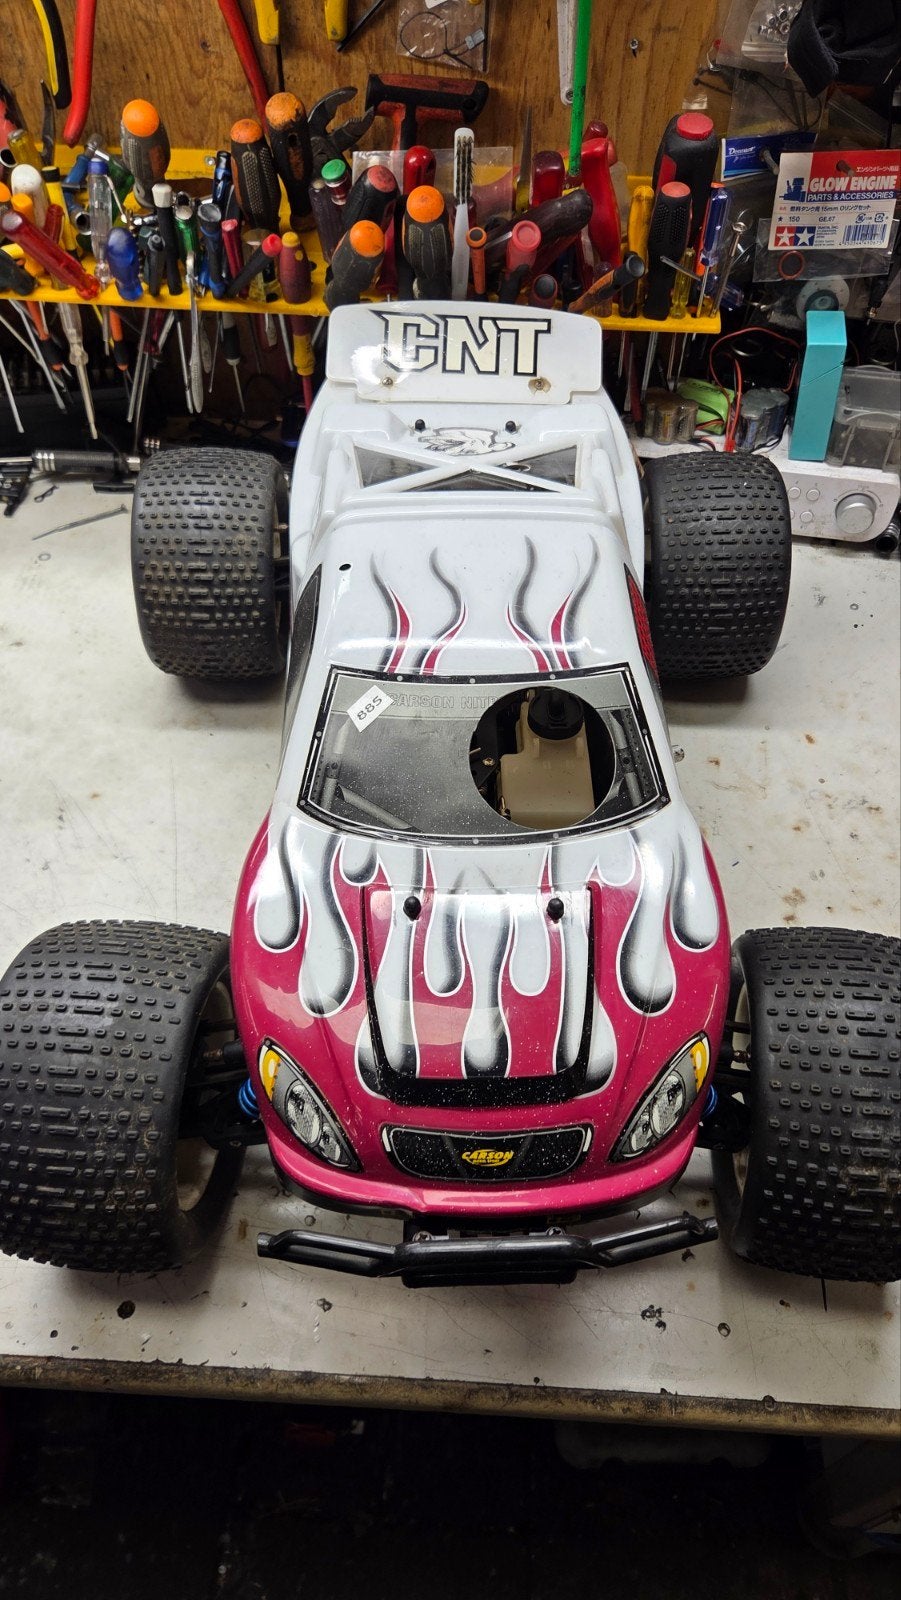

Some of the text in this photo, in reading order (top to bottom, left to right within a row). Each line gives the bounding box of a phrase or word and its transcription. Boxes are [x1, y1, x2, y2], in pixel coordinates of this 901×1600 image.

[809, 175, 897, 192] GLOW ENGINE
[839, 191, 894, 200] ACCESSORIES
[369, 310, 551, 376] CNT
[356, 695, 382, 720] 885
[462, 1150, 514, 1160] CARSON
